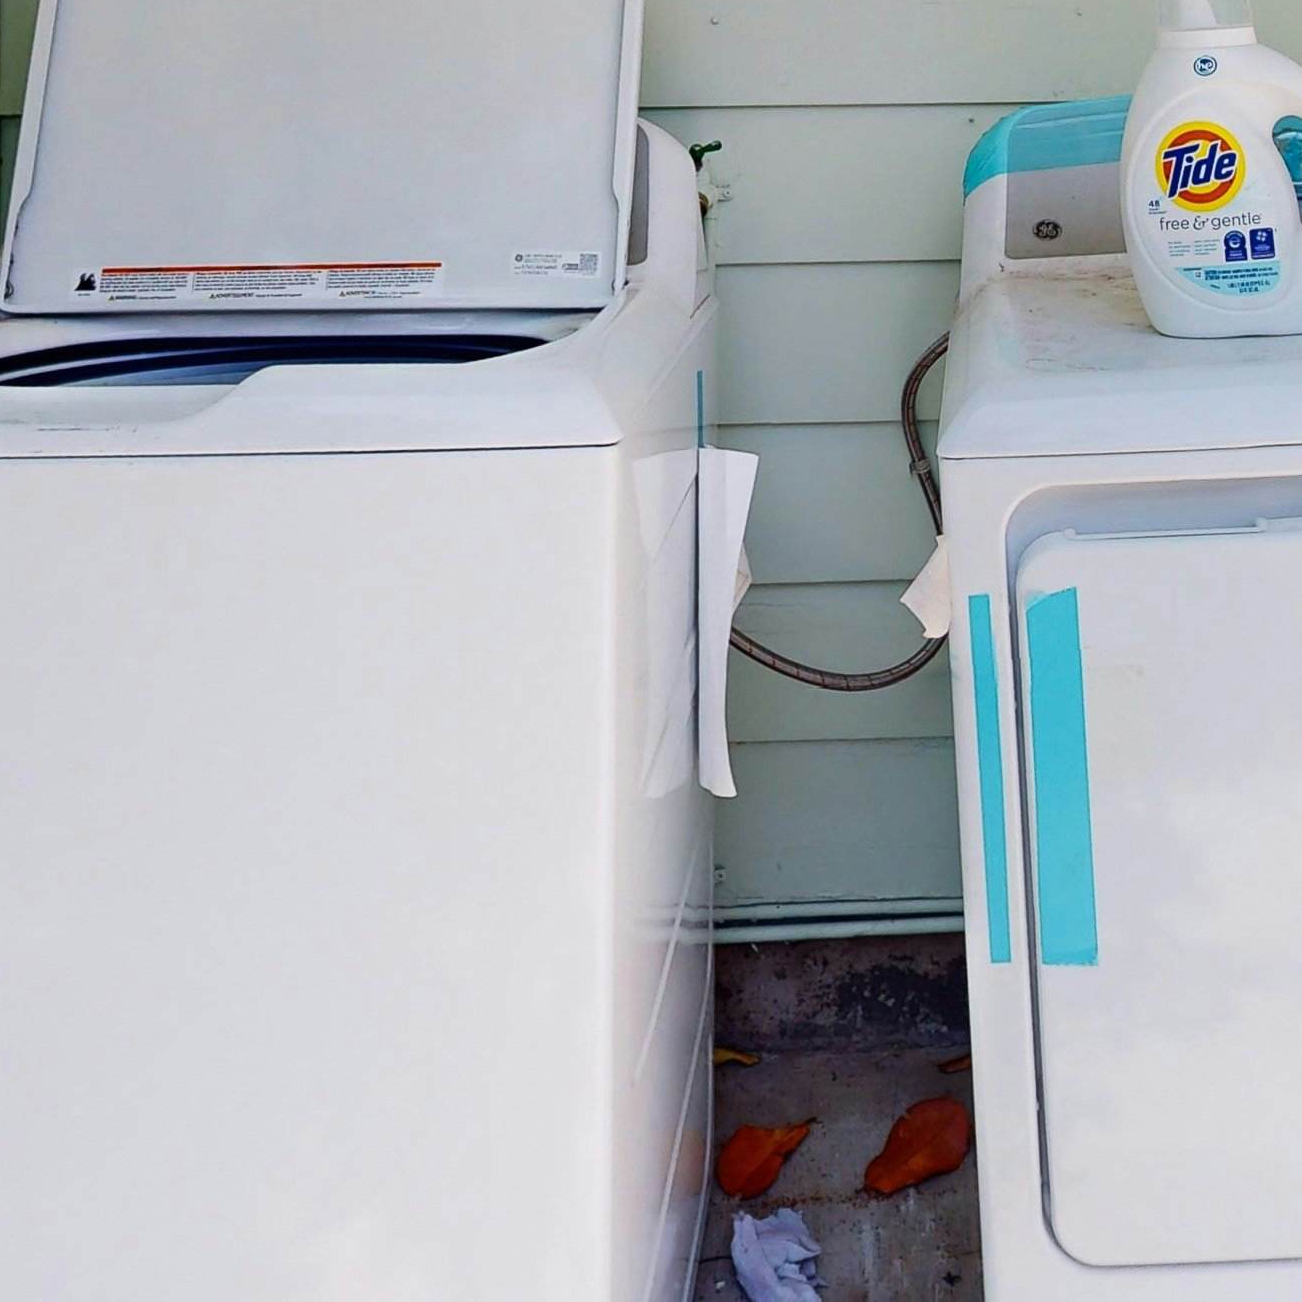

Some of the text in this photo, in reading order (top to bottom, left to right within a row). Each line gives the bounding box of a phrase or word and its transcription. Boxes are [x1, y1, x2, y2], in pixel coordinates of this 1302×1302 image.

[1162, 139, 1238, 199] Tide
[1159, 212, 1261, 231] free & gentle
